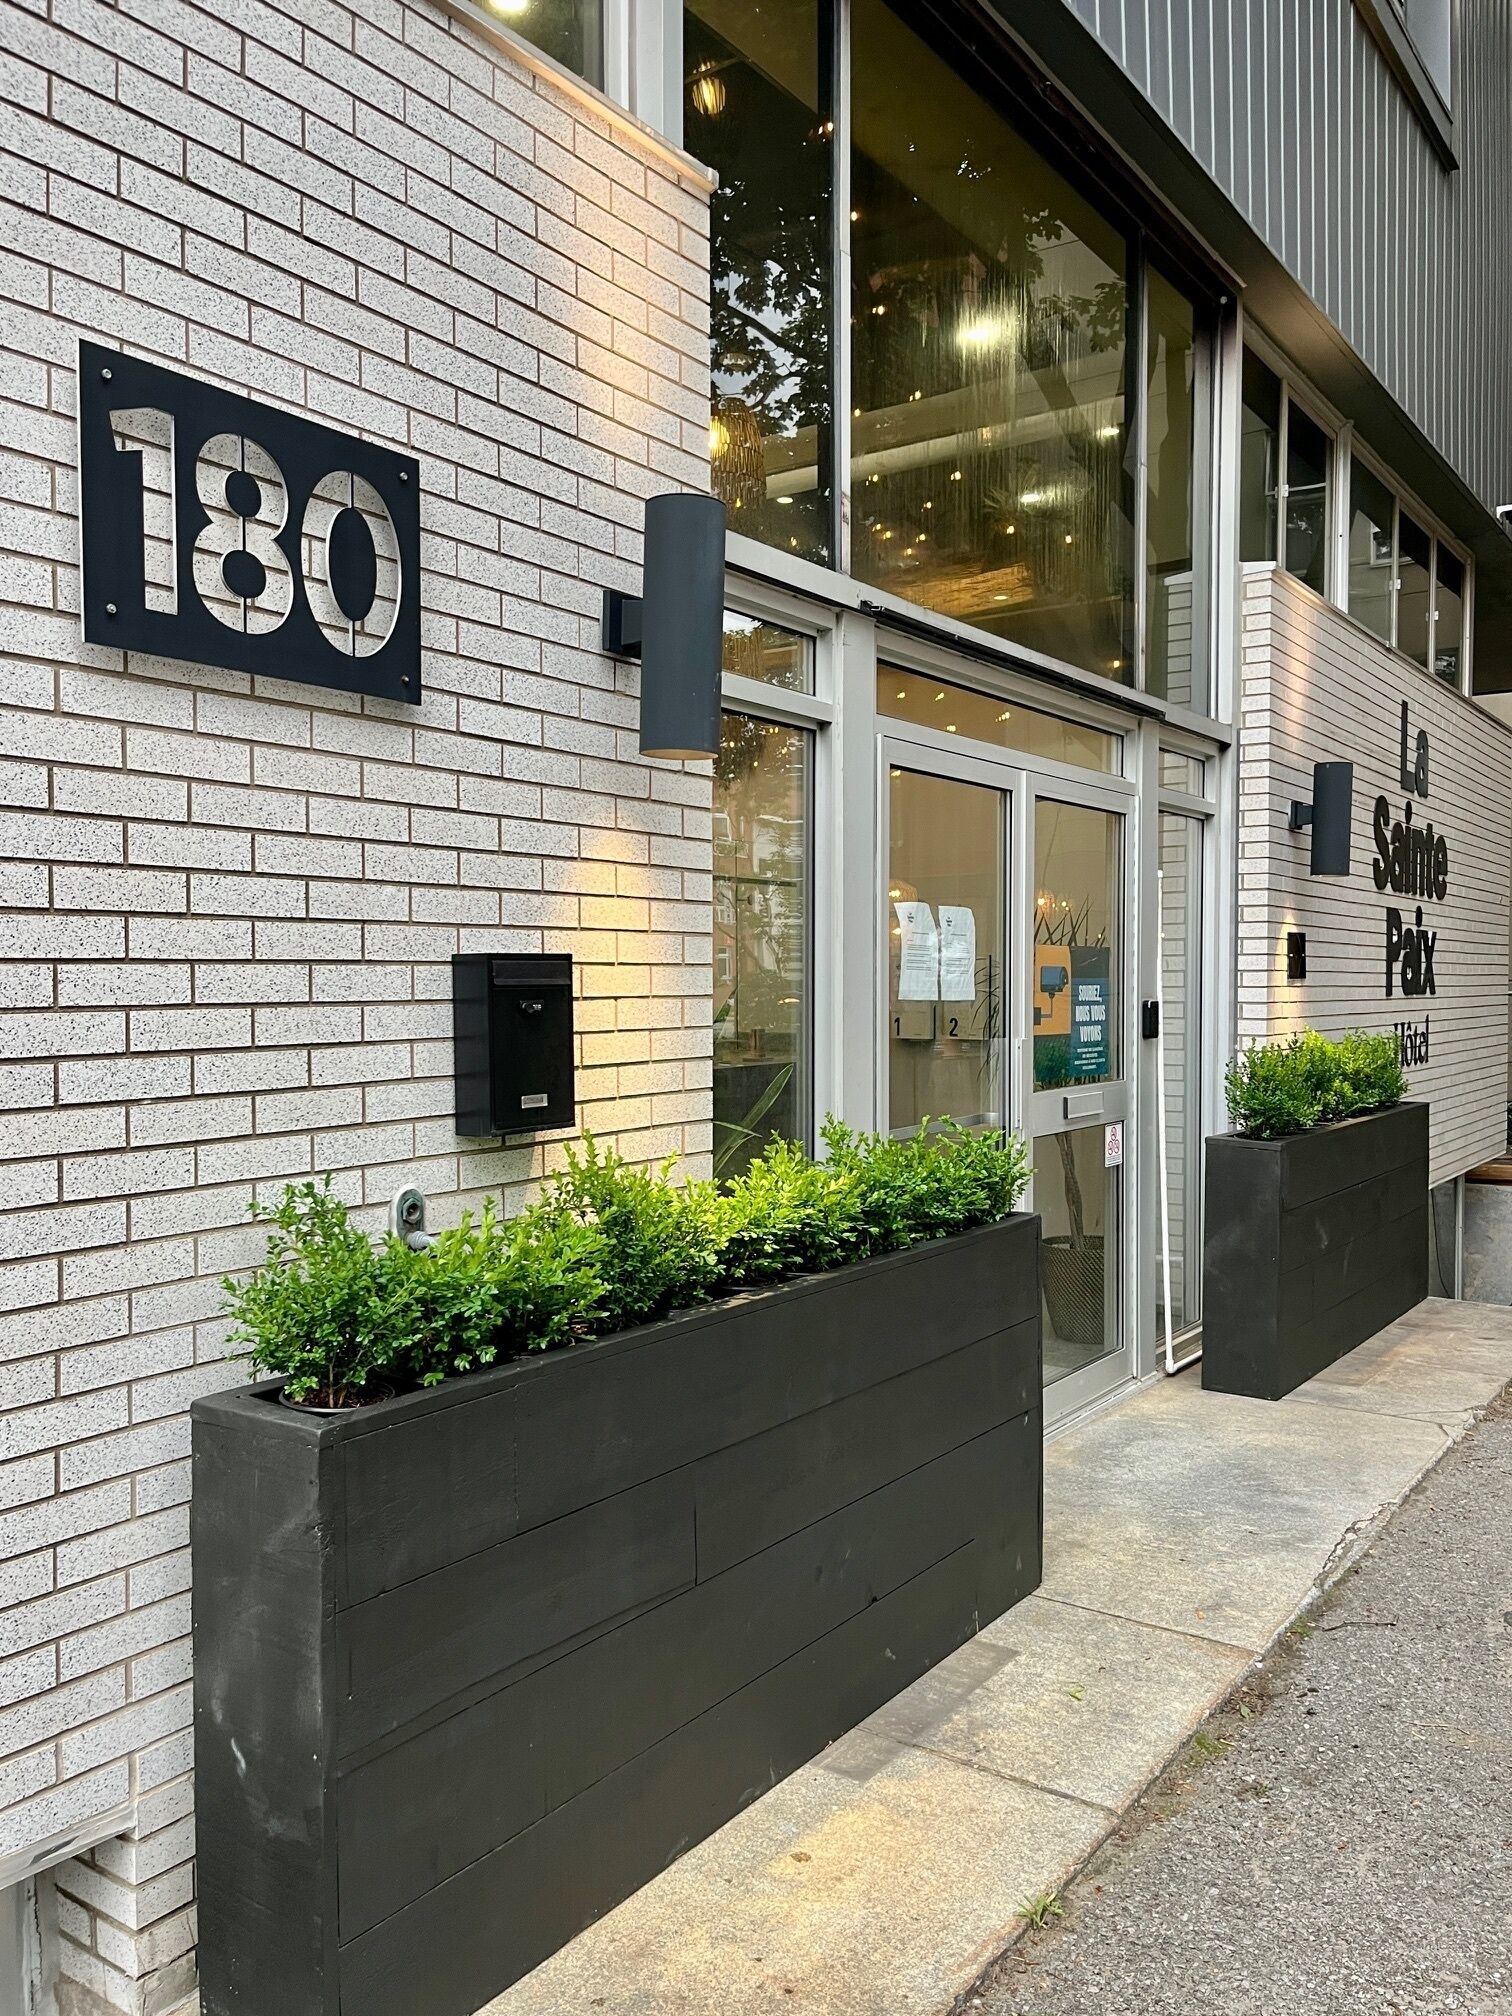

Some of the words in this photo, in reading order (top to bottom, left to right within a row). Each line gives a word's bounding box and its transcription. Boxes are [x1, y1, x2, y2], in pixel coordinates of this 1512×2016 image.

[108, 406, 402, 658] 180
[1400, 699, 1429, 798] La
[1372, 795, 1448, 900] Sainte
[1385, 905, 1436, 997] Paix
[894, 1017, 901, 1037] 1
[949, 1017, 958, 1037] 2
[1075, 1005, 1091, 1022] NOUS
[1090, 1004, 1106, 1021] VOUS
[1079, 1025, 1102, 1042] VOYONS
